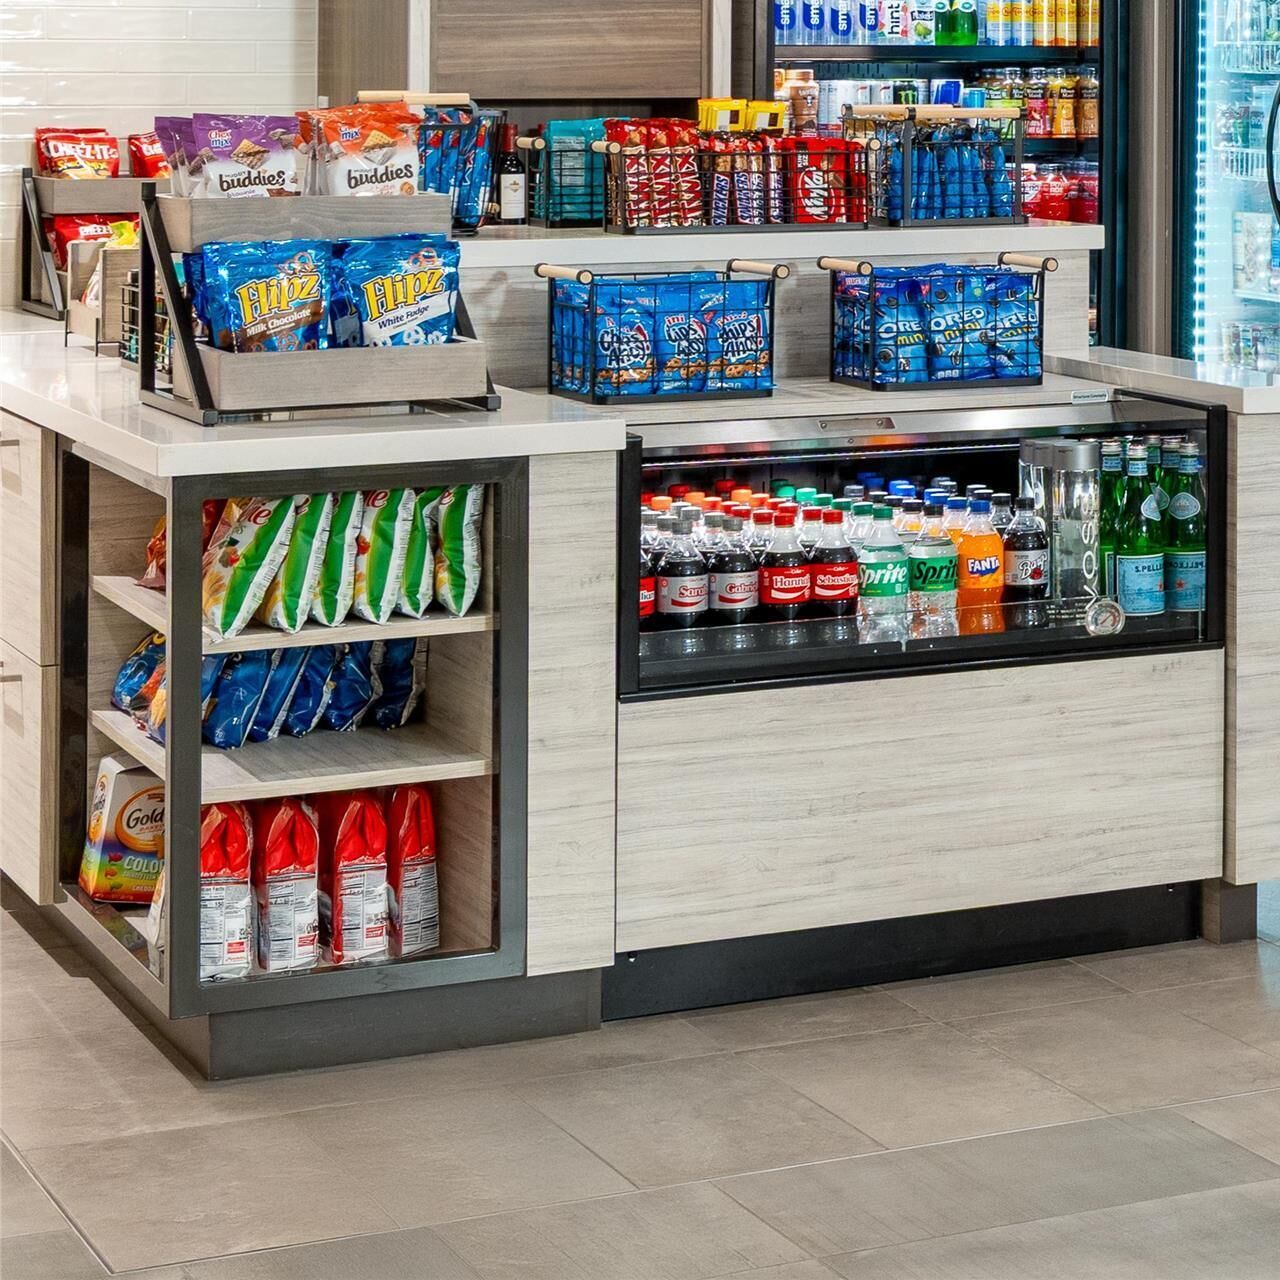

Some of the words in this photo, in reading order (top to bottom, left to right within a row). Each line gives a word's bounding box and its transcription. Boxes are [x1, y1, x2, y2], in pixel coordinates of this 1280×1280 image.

[888, 3, 900, 35] hint
[211, 138, 231, 148] mix
[341, 130, 360, 140] mix
[218, 170, 286, 192] buddies
[346, 163, 414, 189] buddies
[713, 173, 730, 226] SNICKERS
[237, 272, 321, 326] Flipz
[363, 268, 445, 322] Flipz
[246, 324, 268, 337] Milk
[267, 308, 311, 330] Chocolate
[378, 313, 405, 329] White
[405, 305, 431, 320] Fudge
[930, 308, 984, 331] OREO
[986, 314, 1037, 337] OREO
[878, 321, 922, 339] ORE
[897, 333, 925, 345] min
[1081, 493, 1097, 610] VOSS
[859, 563, 908, 588] Sprite
[126, 807, 165, 829] Gold
